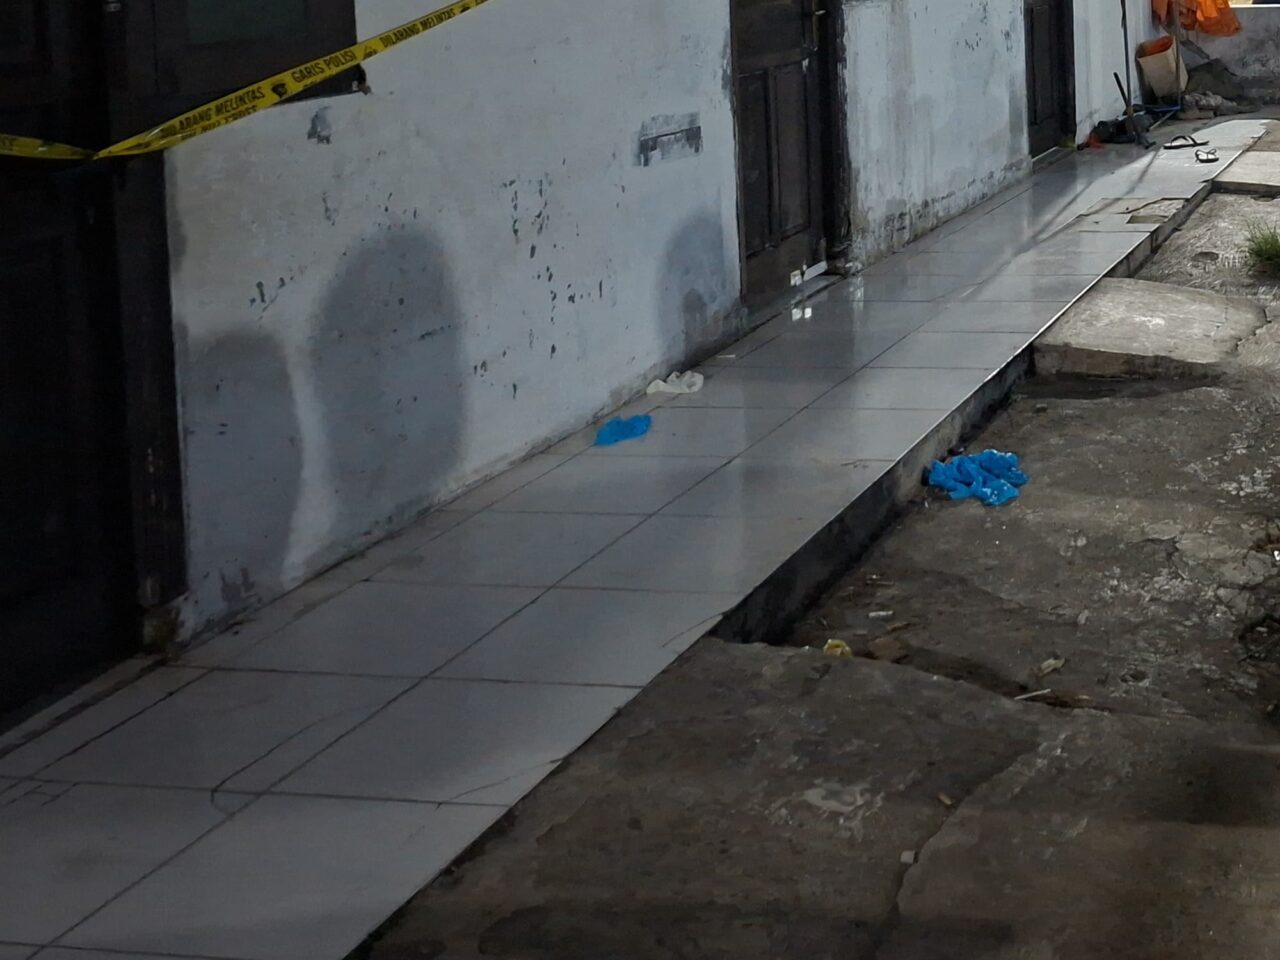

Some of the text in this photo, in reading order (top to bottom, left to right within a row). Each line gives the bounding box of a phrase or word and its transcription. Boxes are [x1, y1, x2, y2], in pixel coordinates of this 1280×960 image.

[291, 60, 325, 84] GARIS
[324, 49, 358, 72] POLISI
[215, 86, 266, 118] MELINTAS
